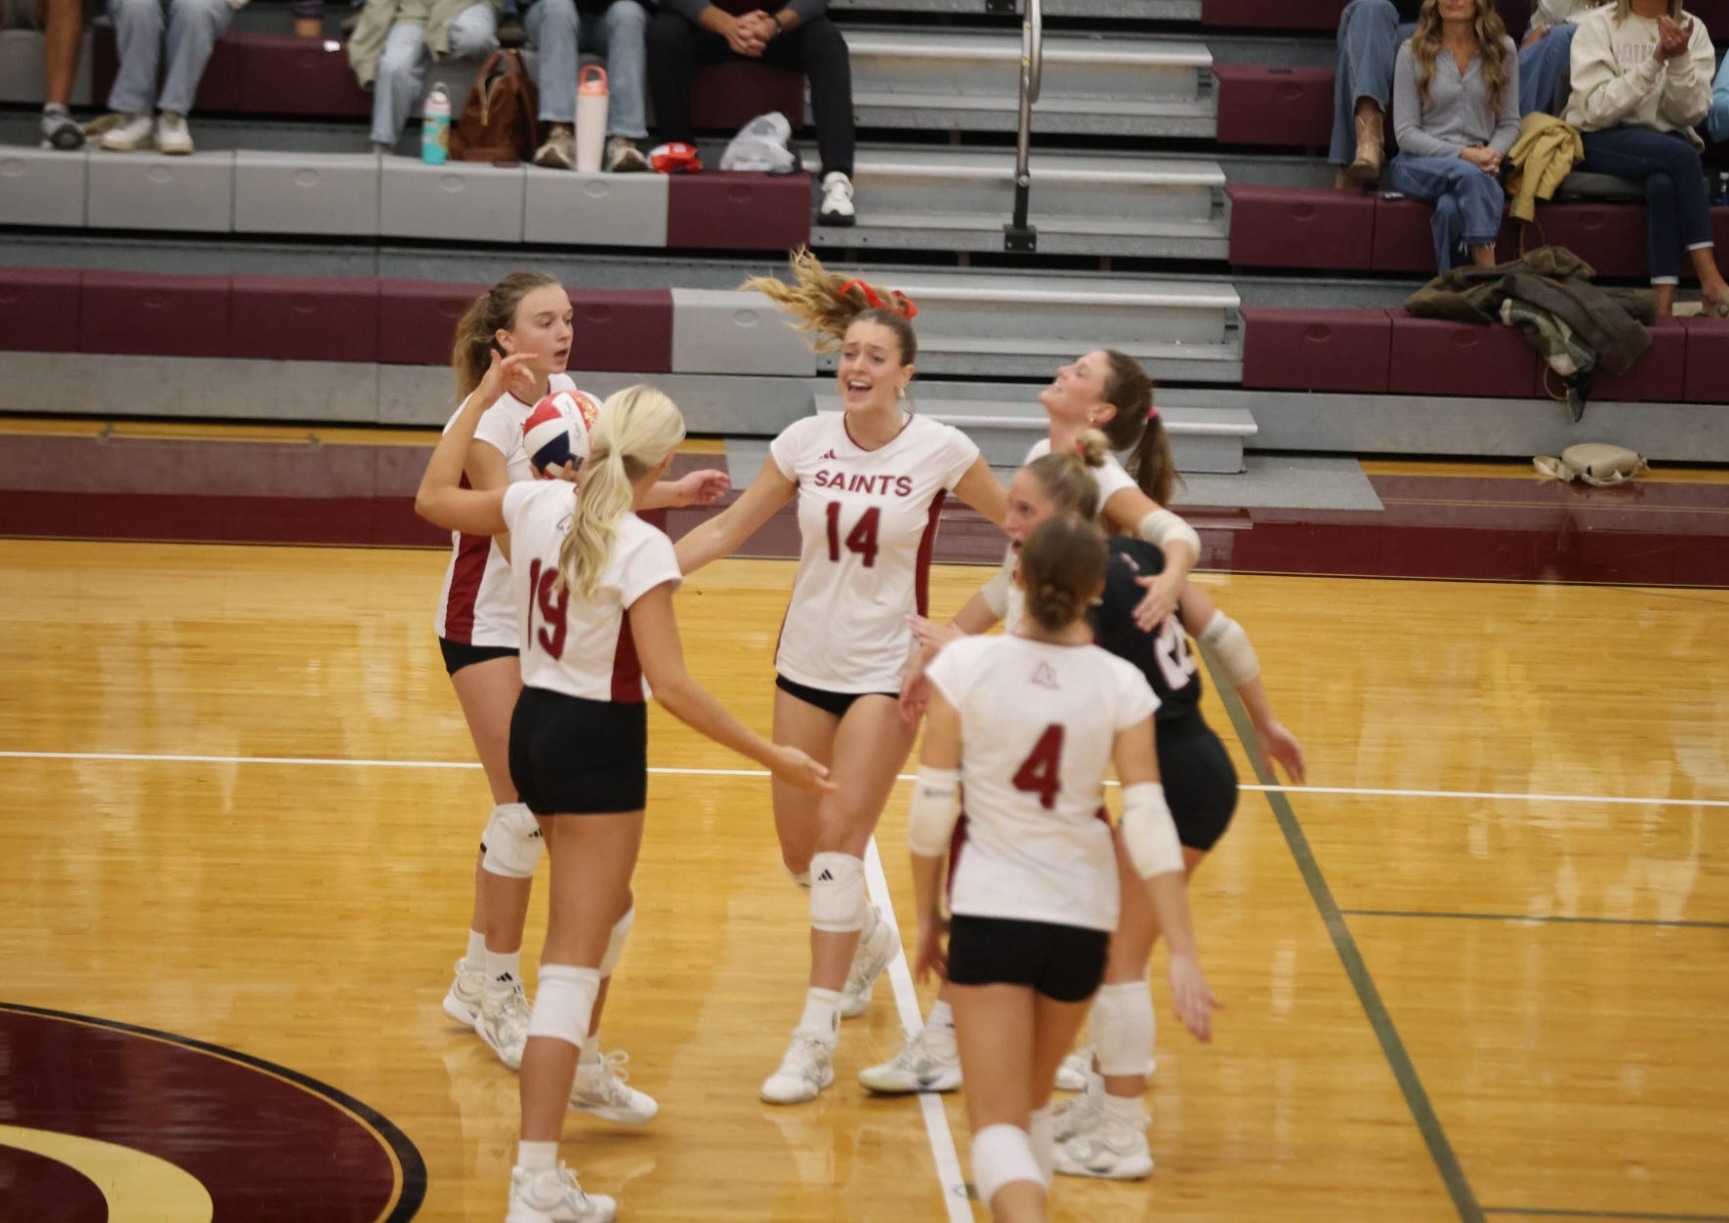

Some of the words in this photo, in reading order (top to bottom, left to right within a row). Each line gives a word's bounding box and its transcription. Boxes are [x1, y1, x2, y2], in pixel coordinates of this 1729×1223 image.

[814, 469, 914, 497] SAINTS
[827, 501, 881, 568] 14
[528, 557, 570, 661] 19
[1012, 722, 1066, 810] 4
